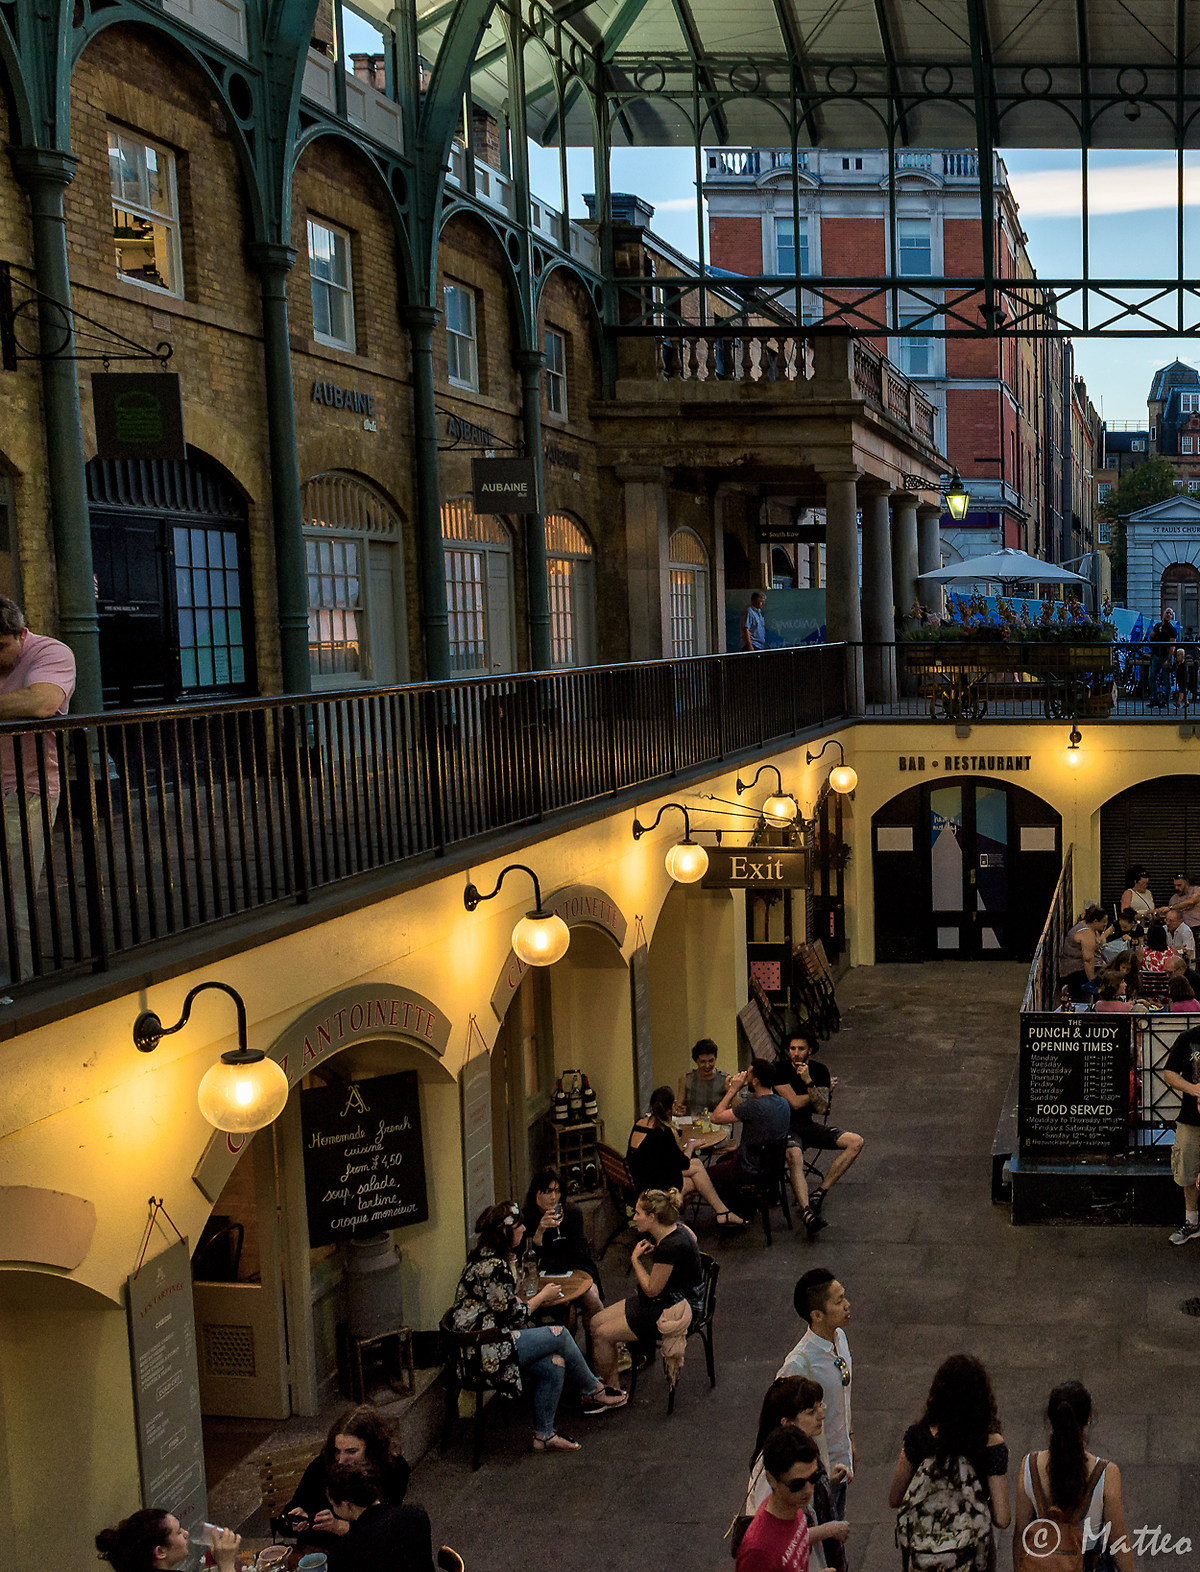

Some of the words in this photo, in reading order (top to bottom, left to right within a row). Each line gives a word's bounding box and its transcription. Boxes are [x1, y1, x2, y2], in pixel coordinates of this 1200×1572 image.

[312, 380, 376, 417] AUBAINE
[481, 482, 528, 493] AUBAINE
[899, 756, 926, 771] BAR
[944, 755, 1032, 771] RESTAURANT
[728, 855, 784, 880] Exit
[302, 1000, 437, 1067] ANTOINETTE
[1028, 1027, 1070, 1038] PUNCH
[1073, 1027, 1082, 1038] &
[1085, 1027, 1119, 1038] JUDY
[1031, 1041, 1080, 1052] OPENING
[1082, 1042, 1113, 1052] TIMES
[1030, 1054, 1059, 1062] Monday
[1030, 1061, 1062, 1069] Tuesday
[1030, 1067, 1072, 1075] Wednesday
[1030, 1074, 1064, 1082] Thursday
[1030, 1080, 1054, 1088] Friday
[1030, 1087, 1064, 1095] Saturday
[1030, 1094, 1059, 1102] Sunday
[1036, 1104, 1068, 1115] FOOD
[1070, 1104, 1113, 1115] SERVED
[1029, 1116, 1059, 1124] Monday
[1069, 1116, 1101, 1124] Thursday
[1034, 1123, 1059, 1131] Friday
[1065, 1124, 1097, 1132] Saturday
[308, 1125, 366, 1149] Homemade
[1045, 1132, 1070, 1140] Sunday
[344, 1143, 385, 1157] cuisine
[340, 1163, 371, 1183] from
[331, 1214, 369, 1233] croque
[371, 1203, 419, 1221] monsieur
